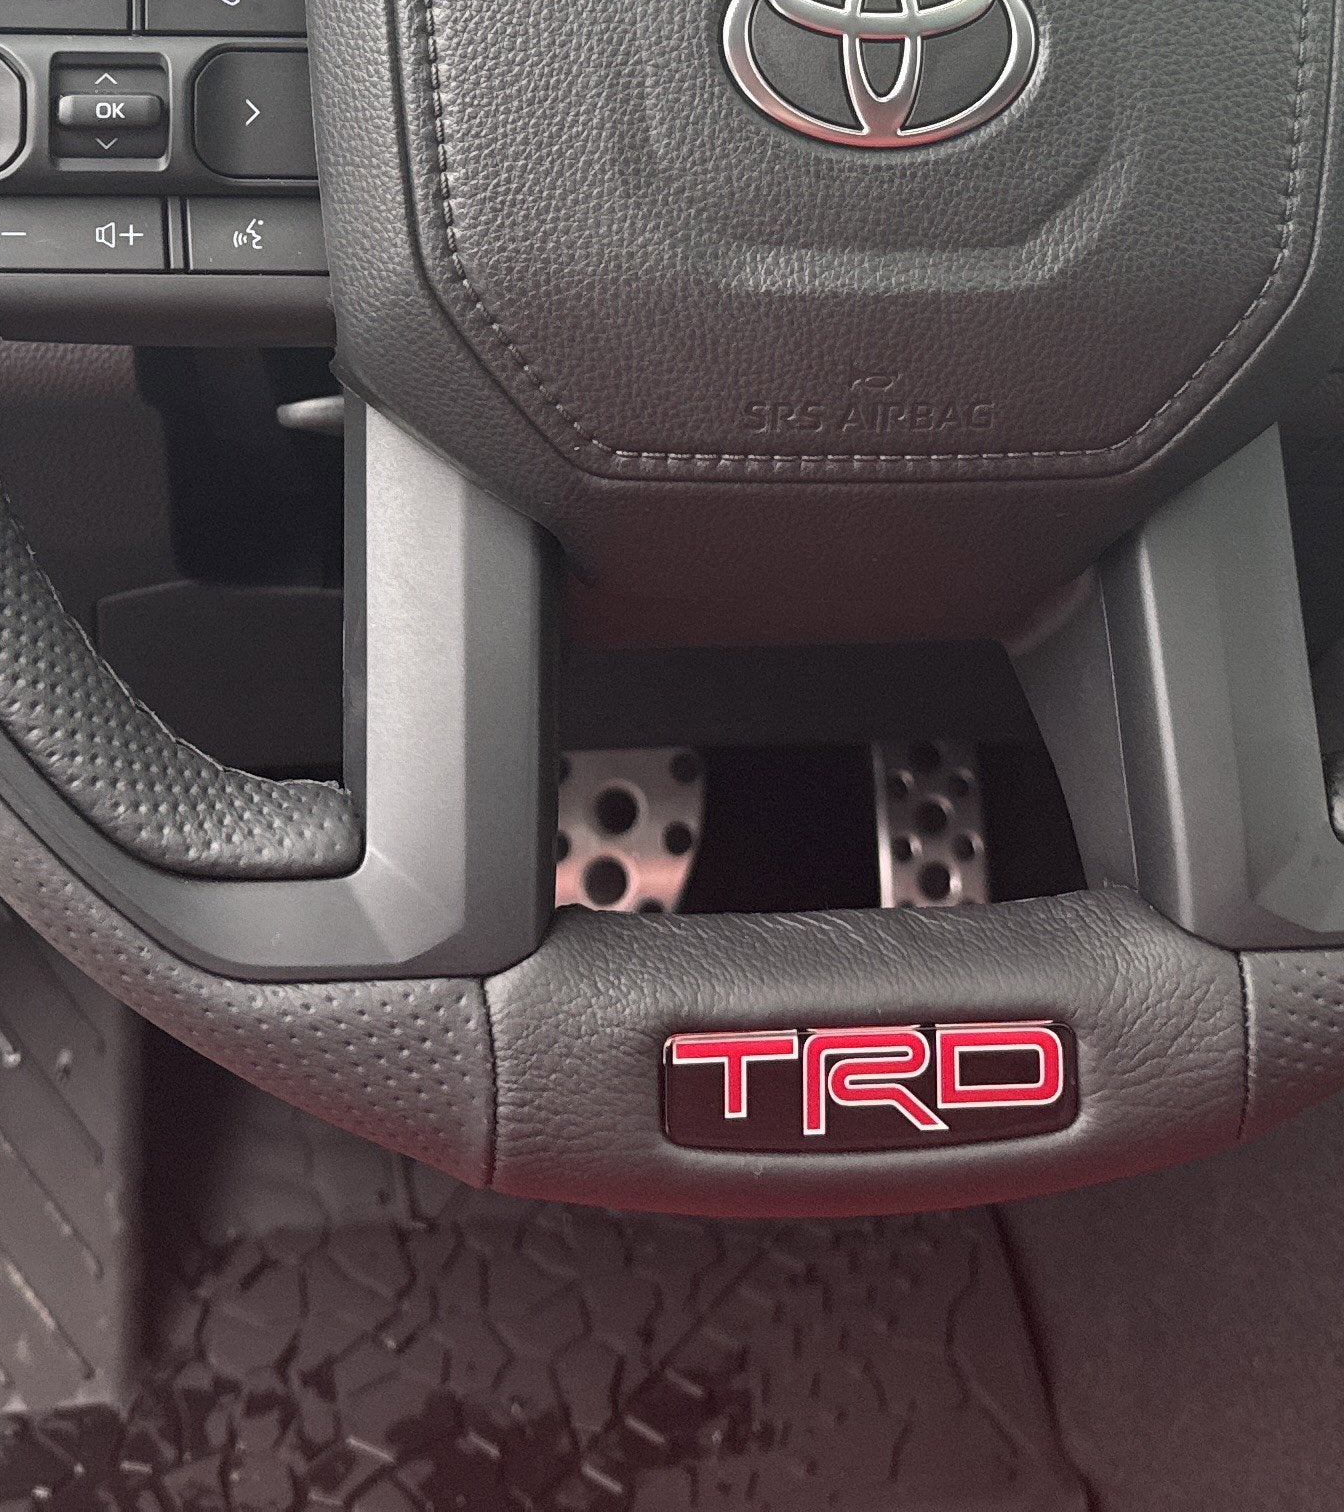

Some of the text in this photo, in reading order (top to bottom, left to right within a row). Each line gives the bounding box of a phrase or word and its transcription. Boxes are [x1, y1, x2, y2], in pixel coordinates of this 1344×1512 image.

[95, 102, 126, 120] OK
[746, 400, 997, 434] SRS AIRBAG
[671, 1022, 1065, 1137] TRD
